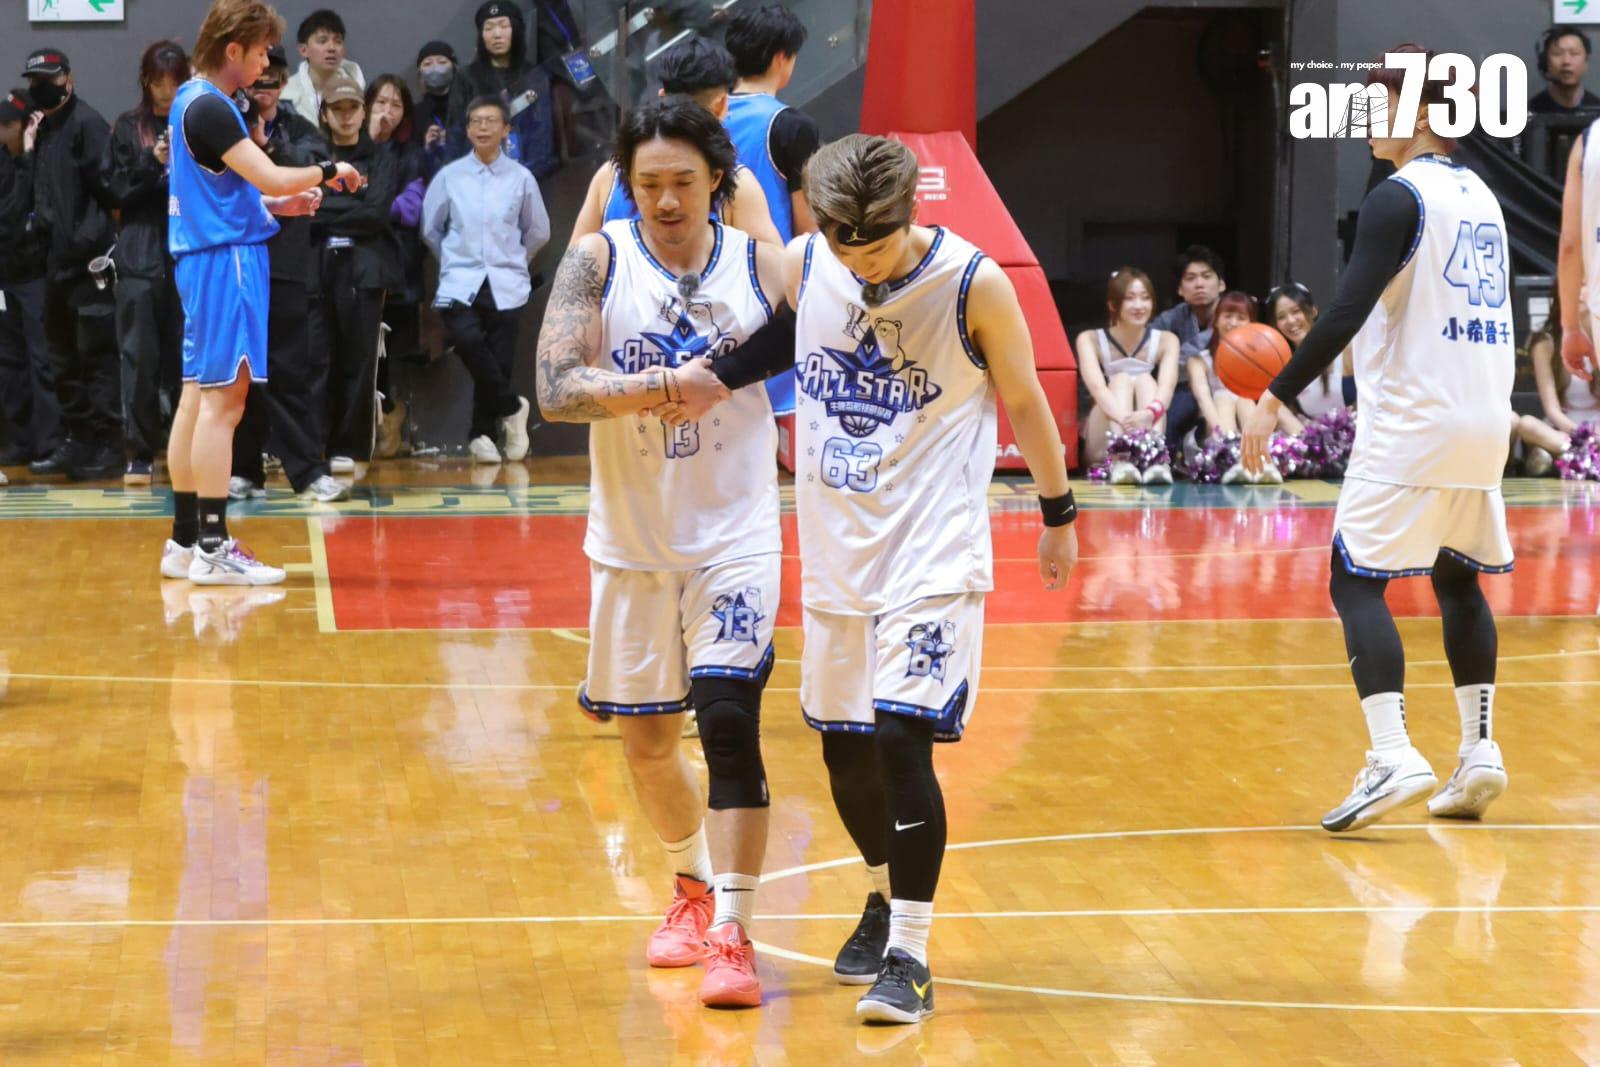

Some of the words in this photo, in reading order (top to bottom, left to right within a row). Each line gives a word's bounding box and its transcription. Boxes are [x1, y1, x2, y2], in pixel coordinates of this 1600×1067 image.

[1443, 220, 1506, 308] 43
[801, 352, 850, 401] ALL
[854, 367, 929, 413] STAR
[661, 416, 700, 459] 13
[820, 436, 883, 493] 63
[724, 606, 756, 642] 13
[909, 640, 953, 681] 63
